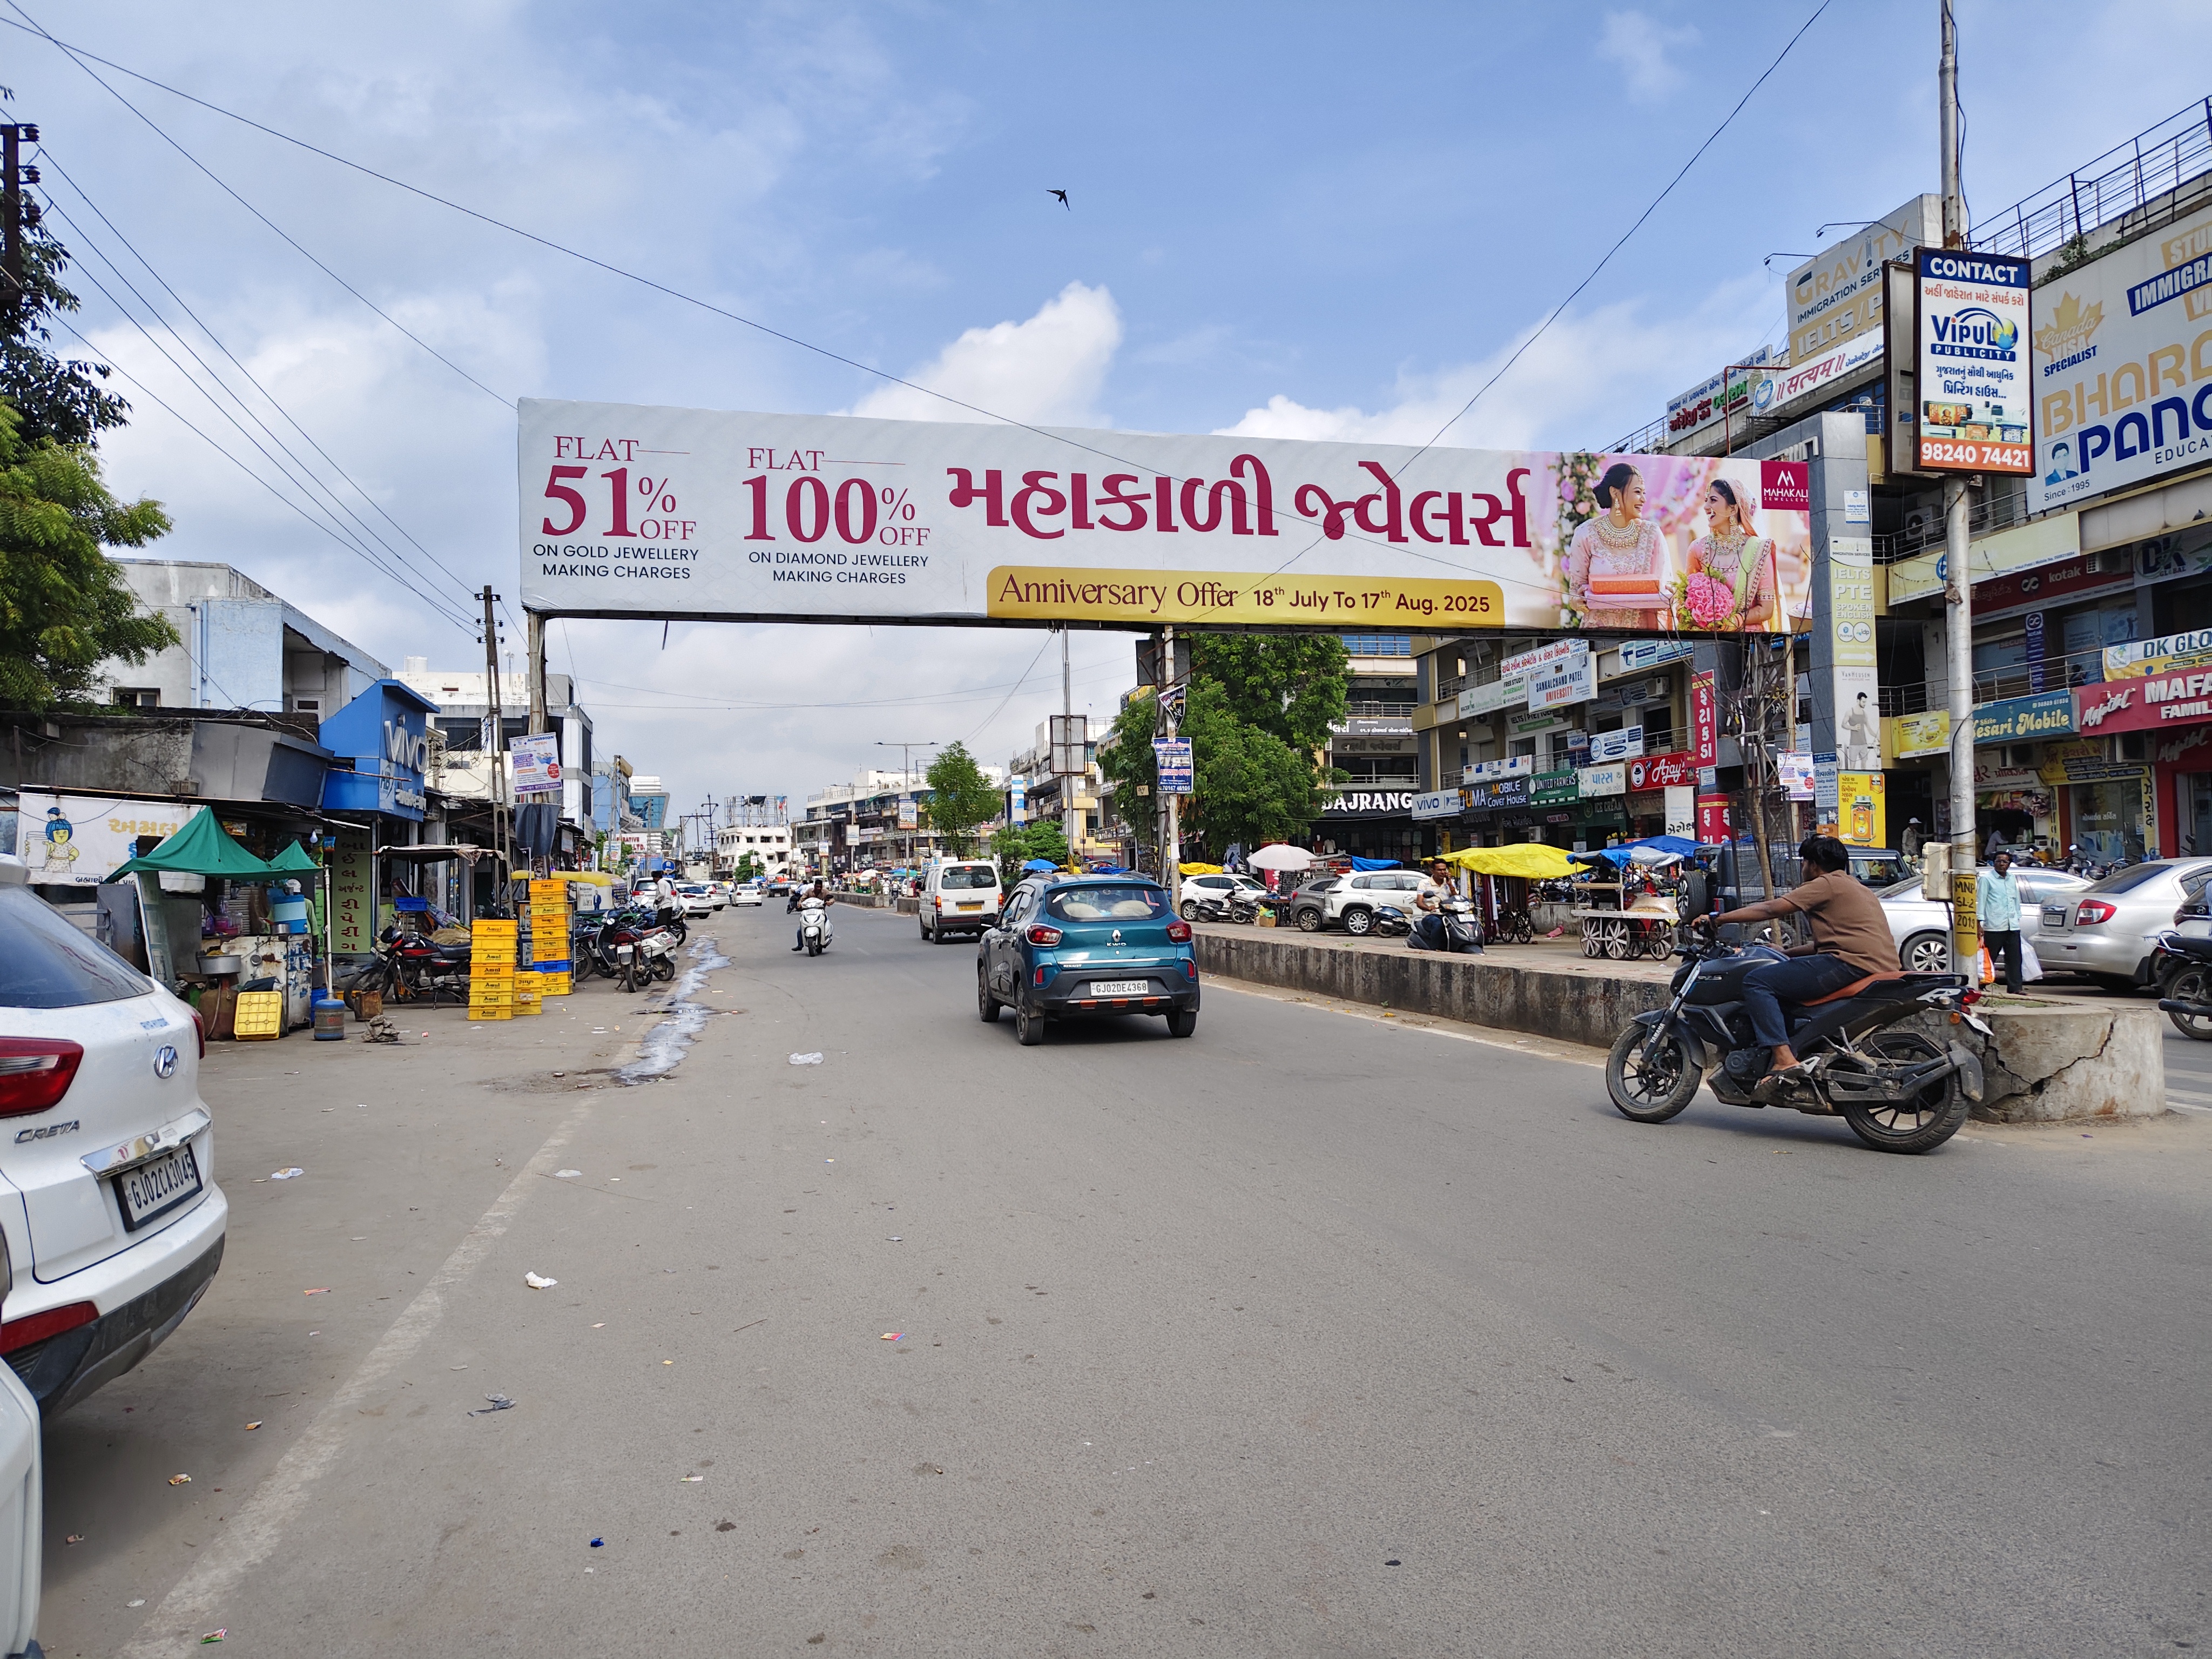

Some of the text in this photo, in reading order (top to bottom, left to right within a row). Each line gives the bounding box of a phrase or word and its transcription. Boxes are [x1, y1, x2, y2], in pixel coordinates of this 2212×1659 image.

[1930, 257, 2018, 284] CONTACT
[1797, 282, 1857, 323] IMMIGRATION
[1924, 284, 2025, 306] અહીં જાહેરાત માટે સંપર્ક કરો
[1797, 311, 1853, 358] IELTS
[2040, 313, 2096, 349] Canada
[1935, 345, 2013, 361] PUBLICITY
[2052, 338, 2089, 362] VISA
[2044, 345, 2098, 377] SPECIALIST
[1936, 365, 2014, 383] ગુજરાતનું સૌથી આધુનિક
[554, 435, 639, 462] FLAT
[1922, 442, 2029, 468] 98240 74421
[747, 448, 825, 471] FLAT
[542, 465, 677, 537] 51%
[947, 453, 1279, 539] મહાકાળી
[1763, 488, 1809, 498] MAHAKALI
[2044, 485, 2067, 501] Since
[741, 475, 916, 545] 100%
[640, 519, 697, 541] OFF
[879, 527, 931, 546] OFF
[533, 544, 699, 562] ON GOLD JEWELLERY
[748, 552, 929, 568] ON DIAMOND JEWELLERY
[542, 563, 691, 579] MAKING CHARGES
[773, 570, 906, 585] MAKING CHARGES
[1834, 568, 1871, 580] IELTS
[2048, 566, 2082, 584] kotak
[999, 574, 1238, 613] Anniversary Offer
[1835, 584, 1872, 601] PTE
[1289, 590, 1328, 612] July
[1333, 591, 1355, 609] To
[1397, 594, 1439, 615] Aug.
[1444, 594, 1489, 612] 2025
[1836, 603, 1873, 611] SPOKEN
[1836, 611, 1873, 619] ENGLISH
[2143, 638, 2169, 658] DK
[1503, 676, 1524, 688] FREE STUDY
[1507, 684, 1525, 694] GERMANY
[1536, 670, 1583, 693] SANKALCHAND PATEL
[1545, 685, 1573, 703] UNIVERSITY
[2015, 709, 2069, 736] Mobile
[384, 713, 428, 774] vivo
[1536, 773, 1576, 790] UNITED FARMERS
[1591, 772, 1613, 785] પારસ
[1815, 768, 1836, 777] શિવાલીક
[1465, 788, 1486, 807] UMA
[1492, 780, 1521, 795] MOBILE
[1487, 794, 1527, 808] Cover House
[1417, 796, 1439, 811] vivo
[1595, 802, 1603, 813] ICE
[1462, 812, 1491, 825] SAMSUNG
[1955, 881, 1975, 894] MNP
[1956, 896, 1974, 908] SL-2
[1957, 914, 1975, 929] 2019
[1096, 982, 1147, 993] GJ02DE4368
[1649, 1022, 1665, 1044] YAMAHA
[14, 1120, 80, 1144] CRETA
[130, 1152, 195, 1210] GJ02CA3045
